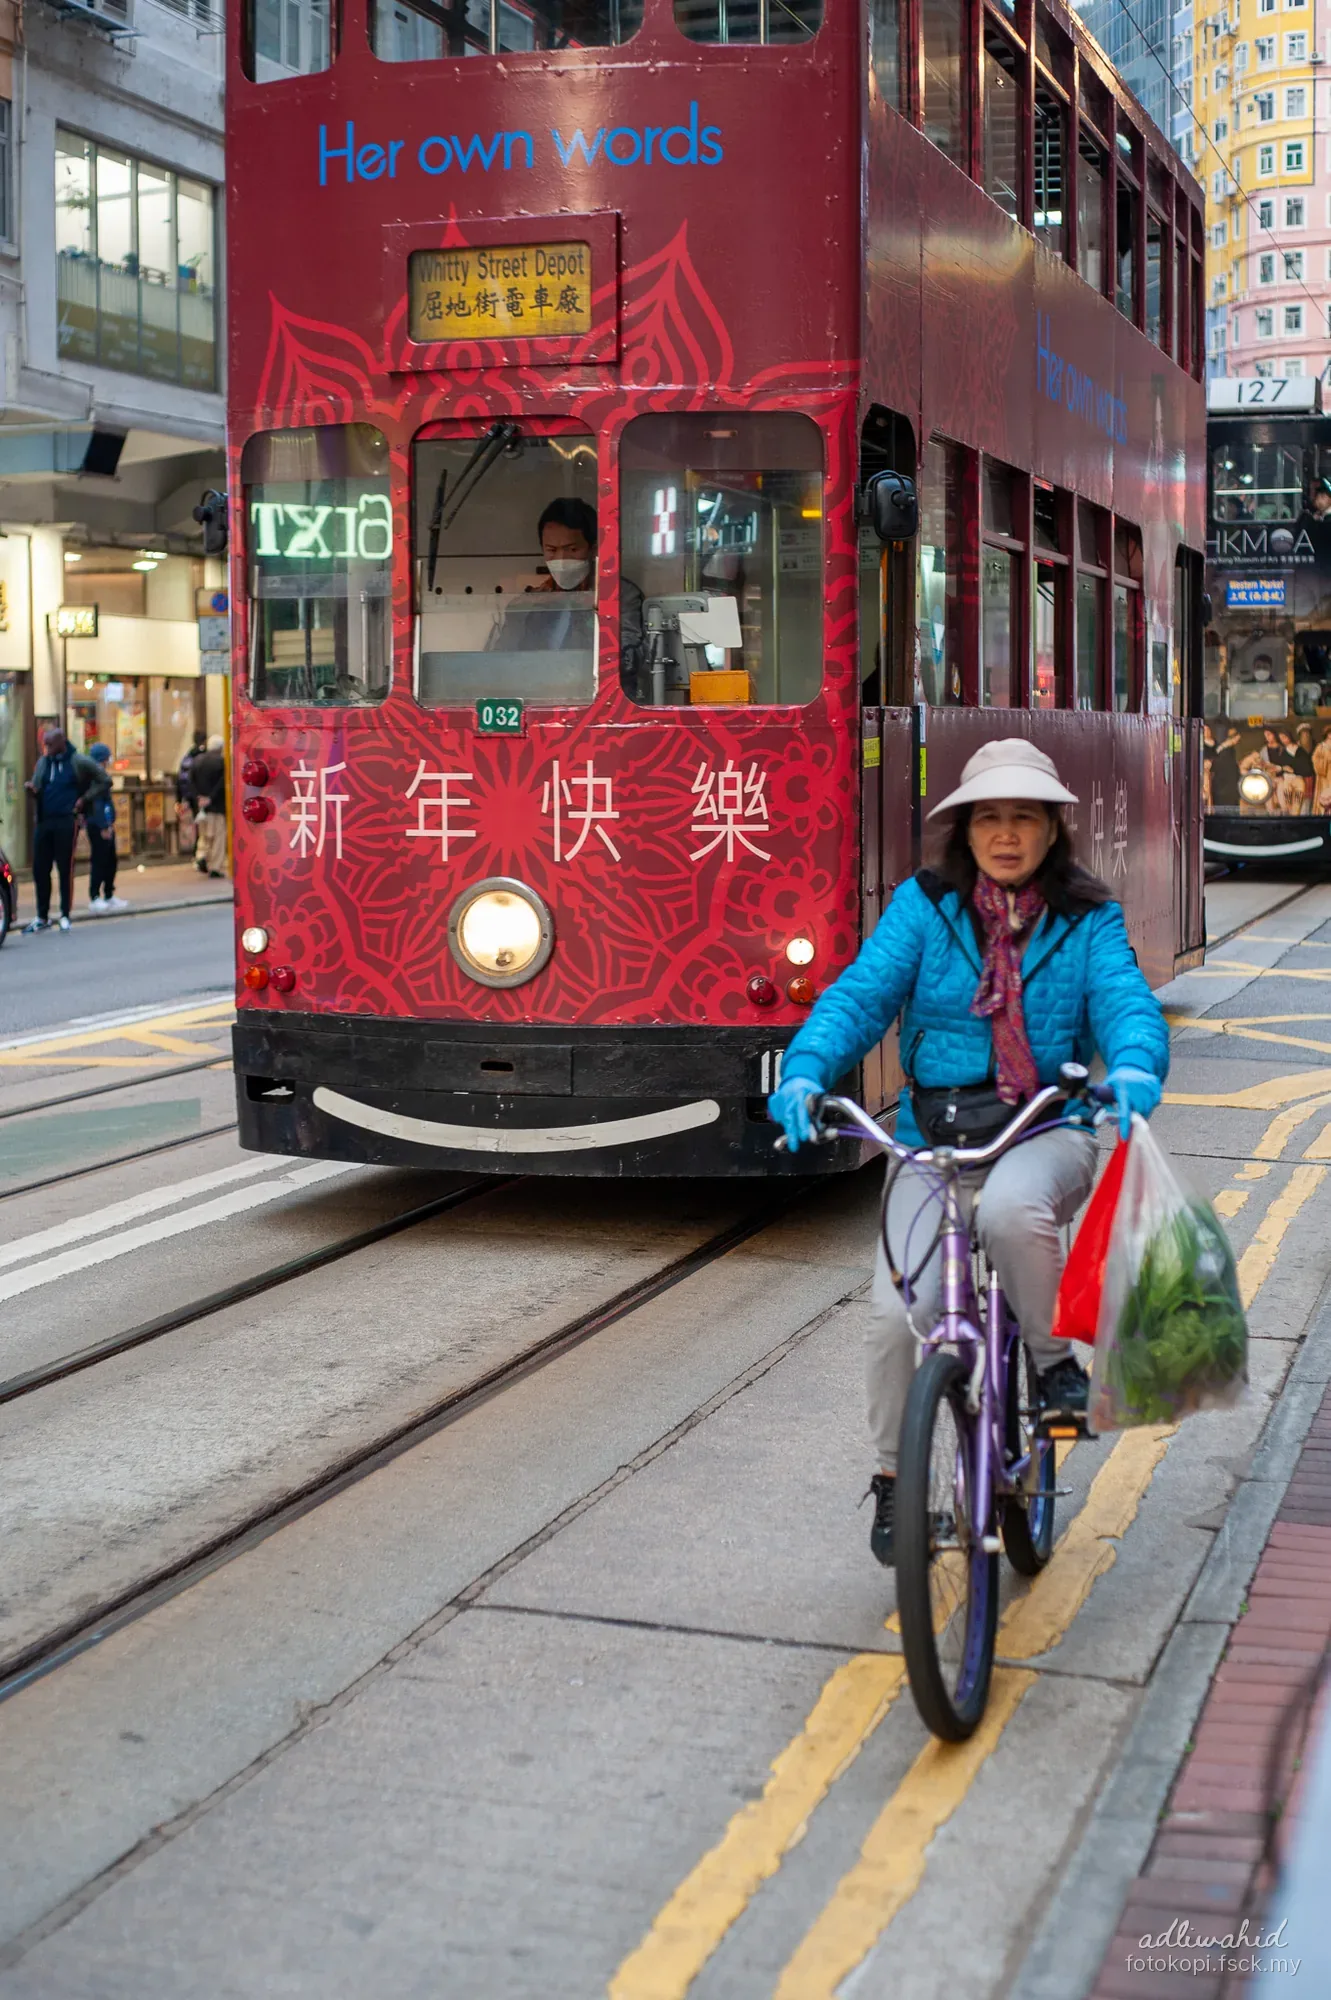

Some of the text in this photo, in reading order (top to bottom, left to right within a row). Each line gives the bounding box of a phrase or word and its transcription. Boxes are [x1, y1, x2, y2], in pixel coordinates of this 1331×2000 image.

[319, 101, 723, 186] Her own words
[419, 249, 585, 287] Whitty Street Depot
[421, 284, 584, 321] 屈地街電車廠
[1037, 307, 1063, 404] Her
[1237, 380, 1288, 402] 127
[482, 706, 519, 726] 032
[289, 759, 771, 862] 新年快樂
